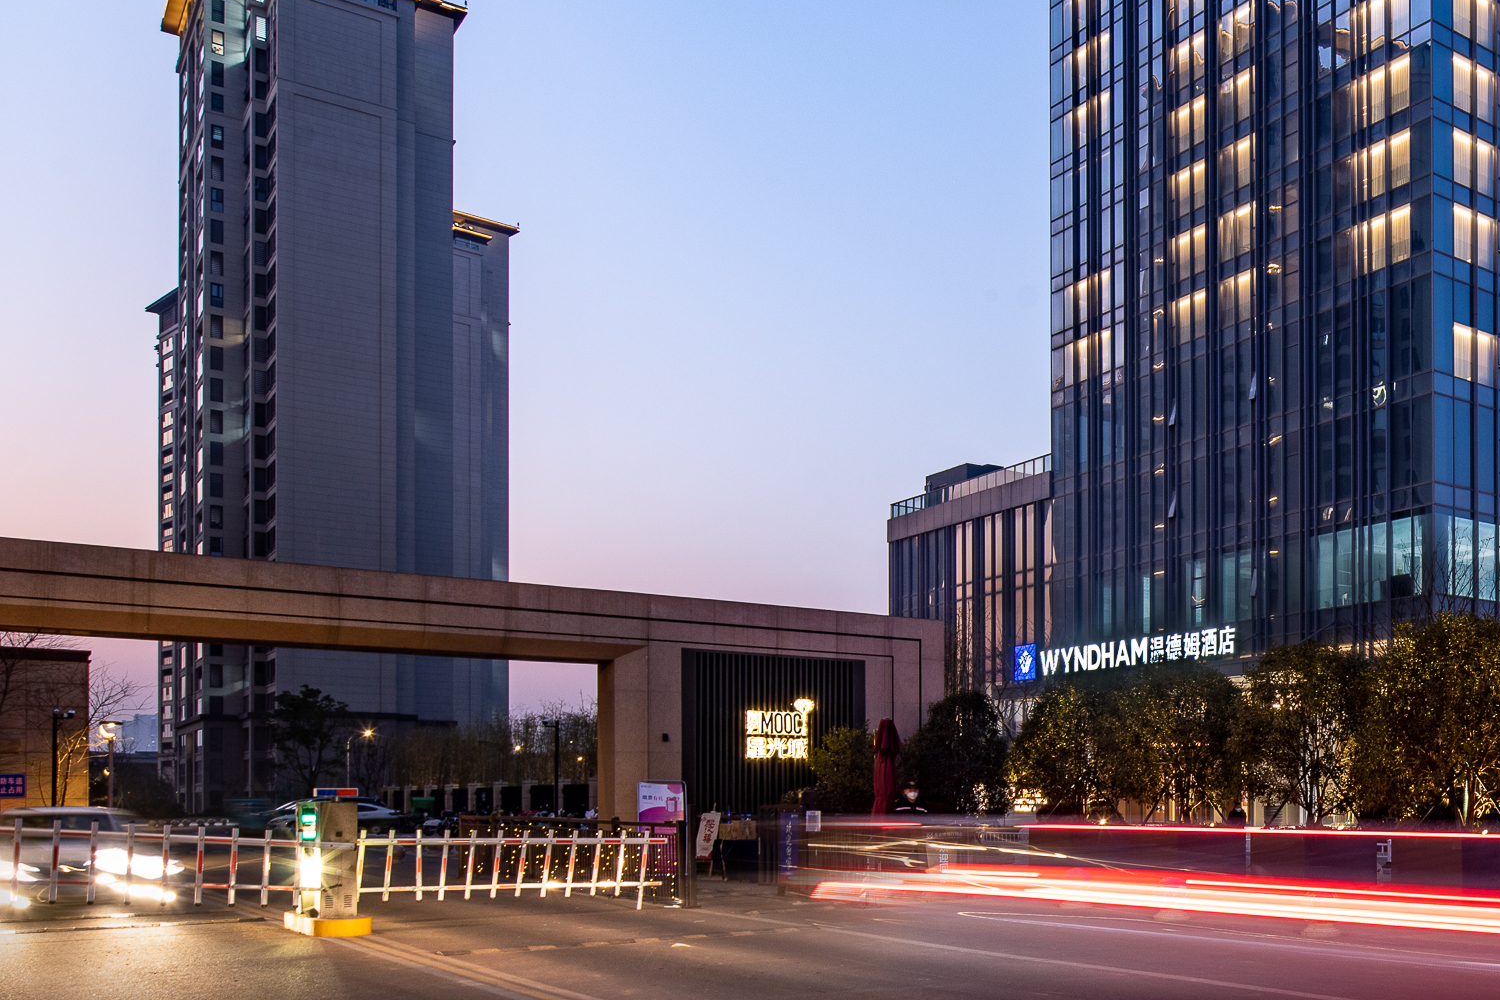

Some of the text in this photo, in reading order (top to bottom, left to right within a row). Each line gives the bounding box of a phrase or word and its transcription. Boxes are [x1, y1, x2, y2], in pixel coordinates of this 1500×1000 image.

[1040, 625, 1236, 676] WYNDHAM 温德姆酒店
[761, 712, 802, 734] MOOC
[746, 737, 808, 759] 星光城
[0, 786, 23, 794] 止占用
